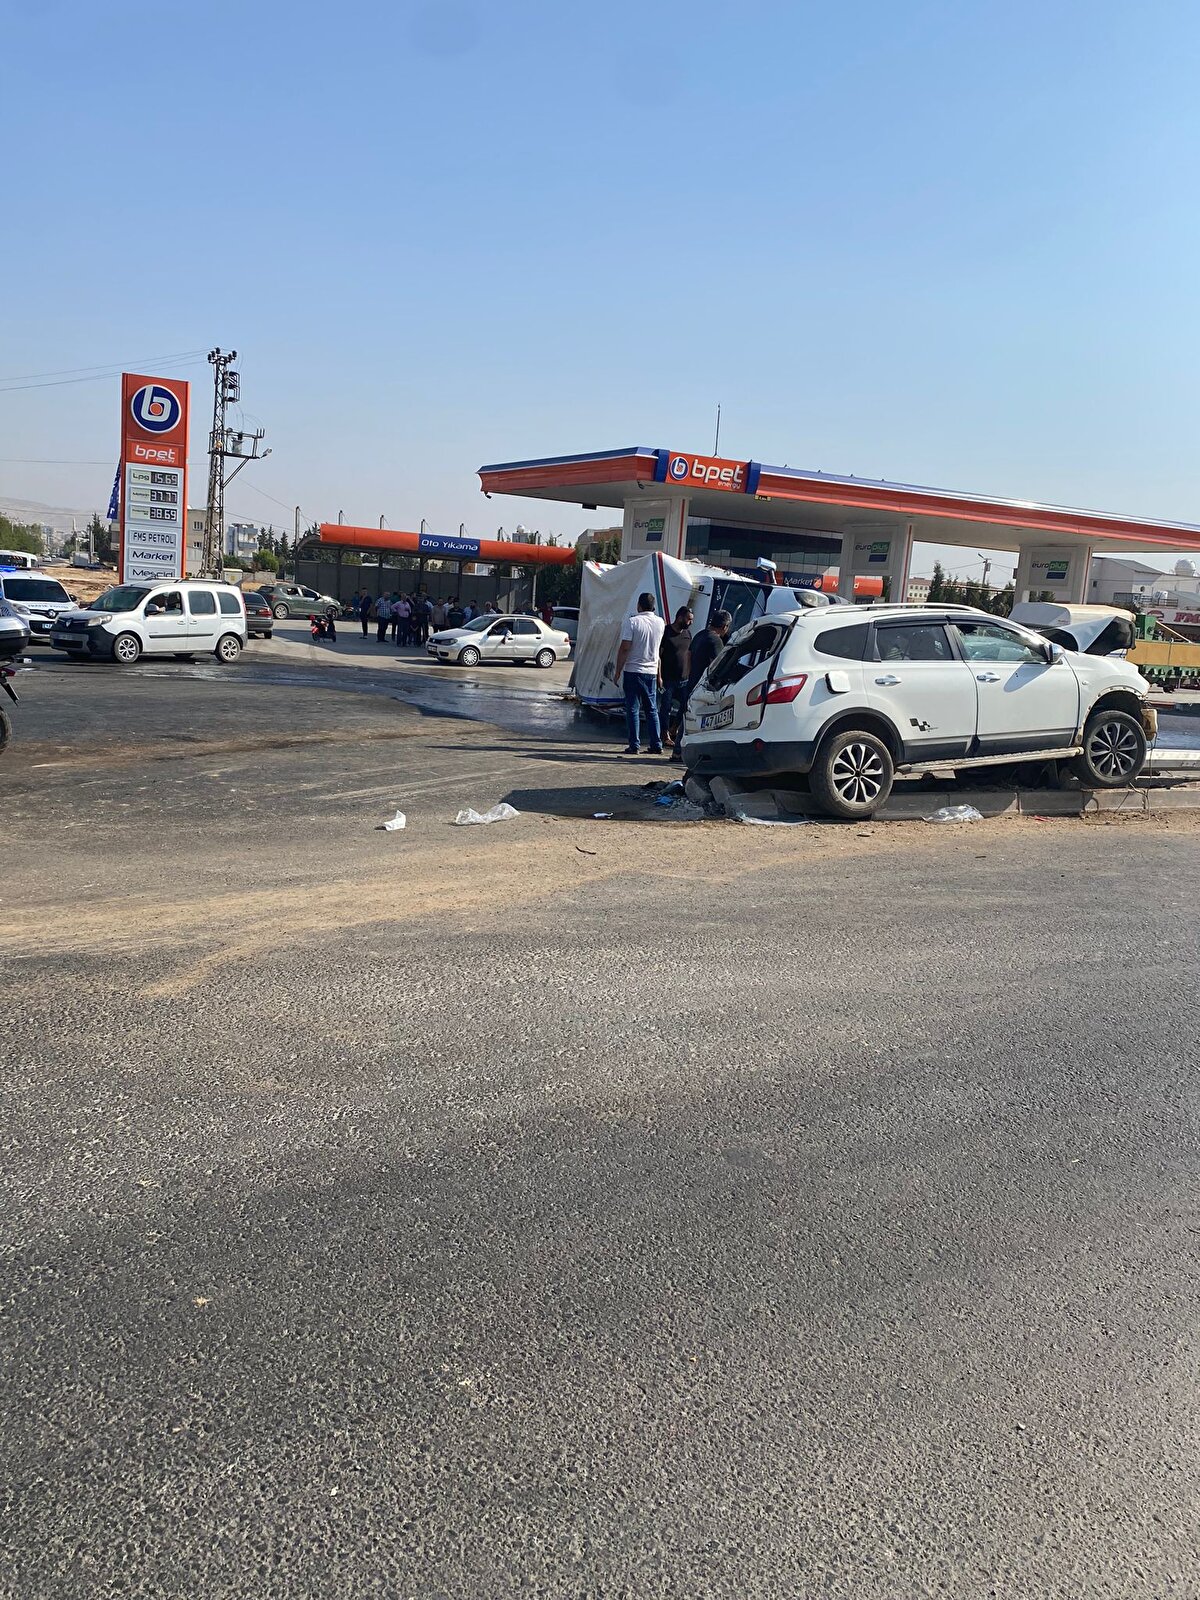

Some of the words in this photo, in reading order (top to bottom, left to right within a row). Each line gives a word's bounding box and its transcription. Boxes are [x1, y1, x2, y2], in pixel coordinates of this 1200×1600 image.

[135, 444, 176, 460] bpet
[692, 458, 744, 483] bpet
[717, 481, 741, 489] energy
[132, 531, 147, 542] FMS
[149, 533, 174, 545] PETROL
[421, 538, 440, 547] Oto
[132, 550, 174, 562] Market
[783, 577, 813, 587] Market
